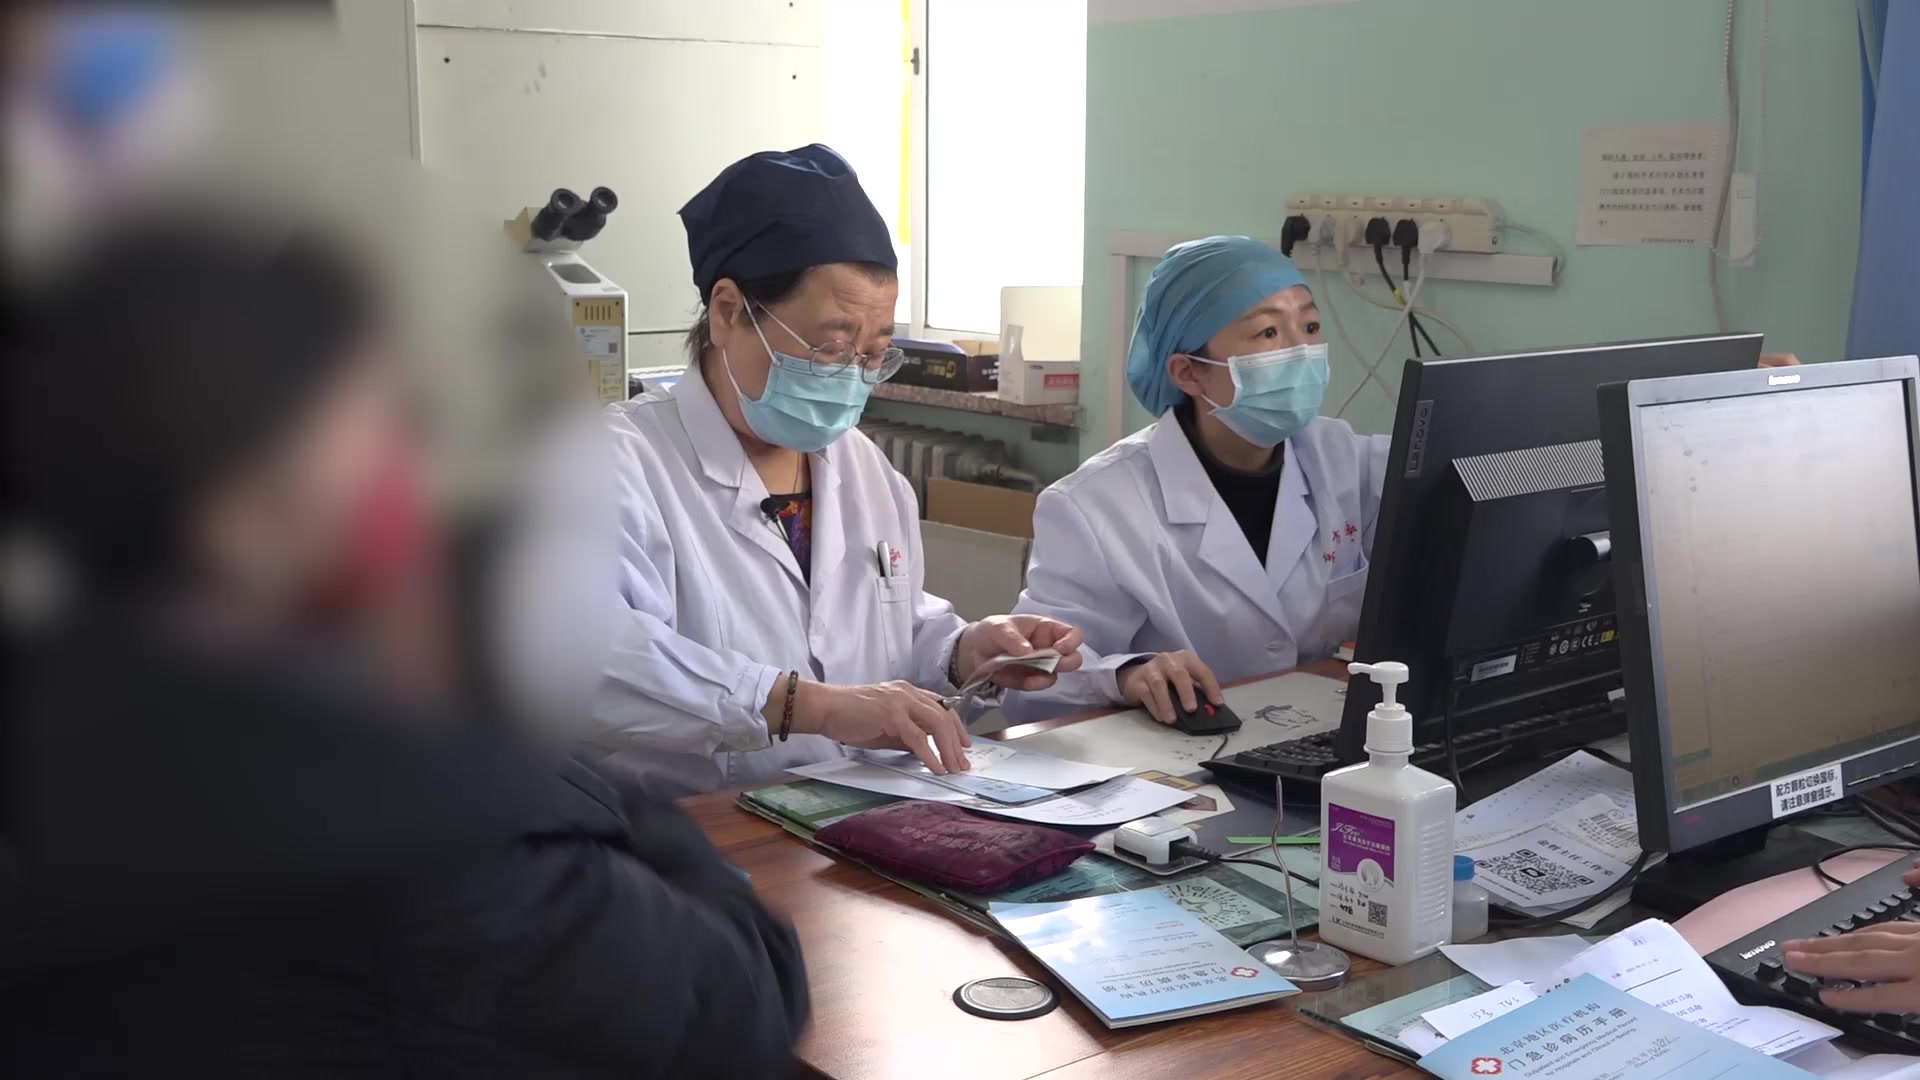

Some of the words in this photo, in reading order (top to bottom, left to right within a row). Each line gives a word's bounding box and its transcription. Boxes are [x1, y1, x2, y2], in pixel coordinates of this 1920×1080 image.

[1409, 407, 1429, 473] Lenovo
[1738, 940, 1776, 960] lenovo
[1102, 966, 1226, 992] 门急诊病历手册
[1500, 1002, 1601, 1056] 北京地区医疗机构
[1508, 1007, 1628, 1070] 门急诊病历手册
[1565, 1040, 1597, 1057] Emergency
[1596, 1028, 1618, 1040] Medical
